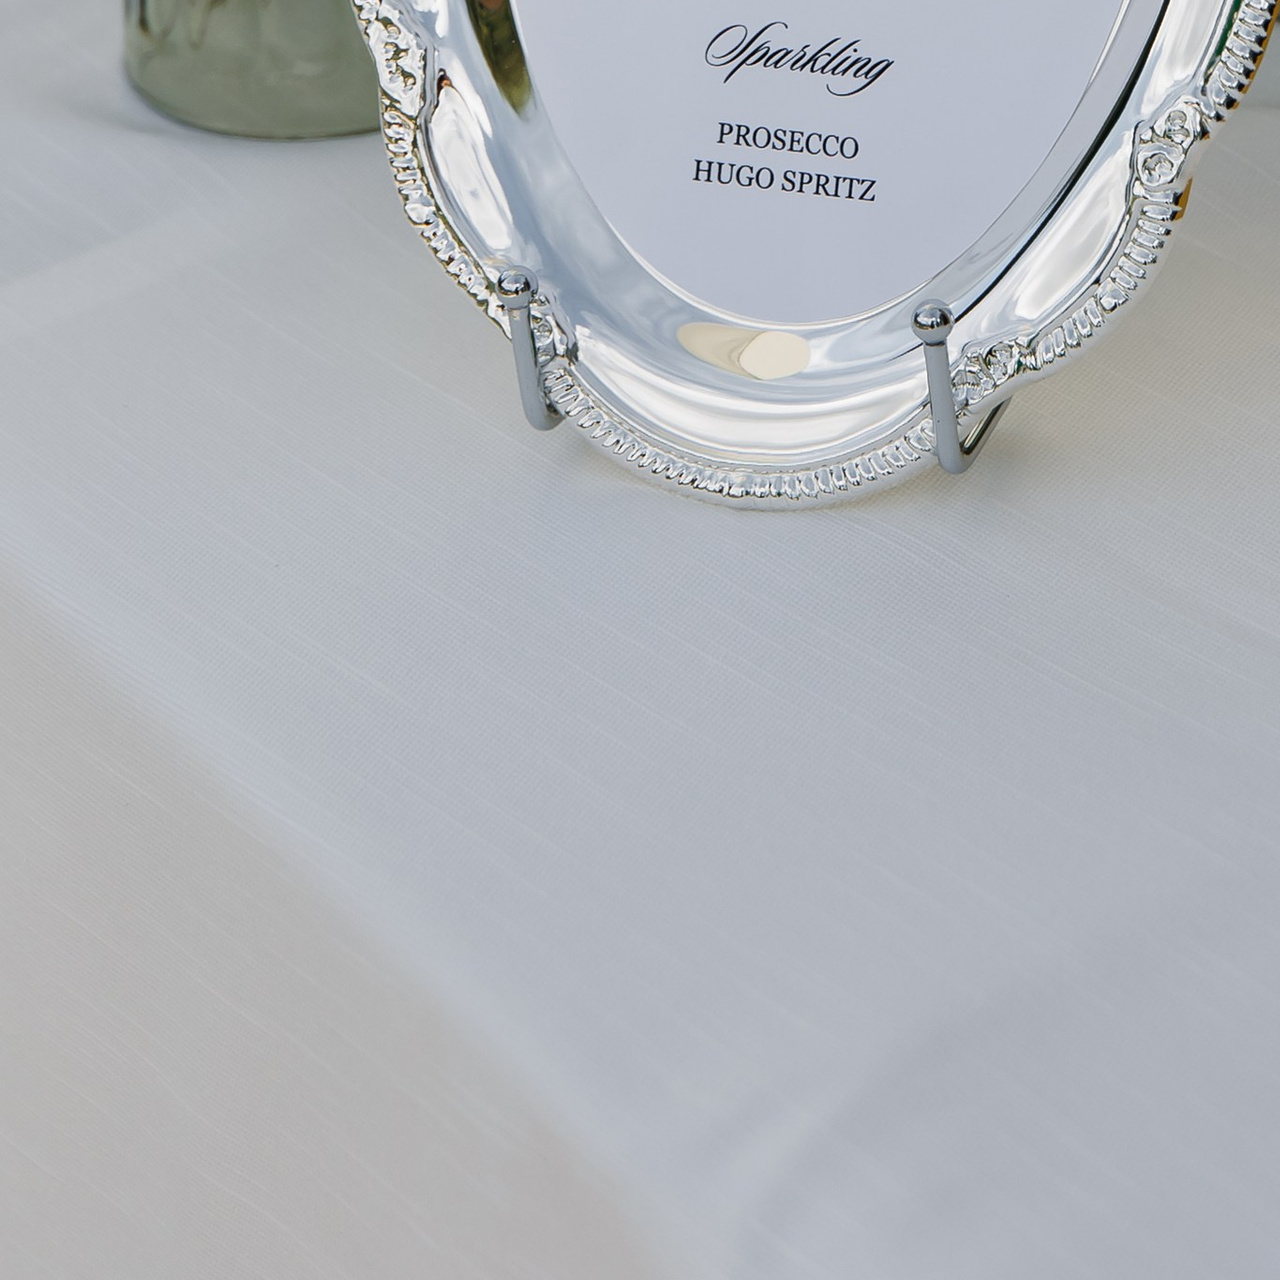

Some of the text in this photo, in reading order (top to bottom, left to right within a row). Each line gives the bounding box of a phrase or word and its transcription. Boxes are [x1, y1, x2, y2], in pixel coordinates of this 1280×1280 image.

[704, 21, 895, 97] Sparkling
[716, 121, 860, 160] PROSECCO
[692, 158, 877, 202] HUGO SPRITZ
